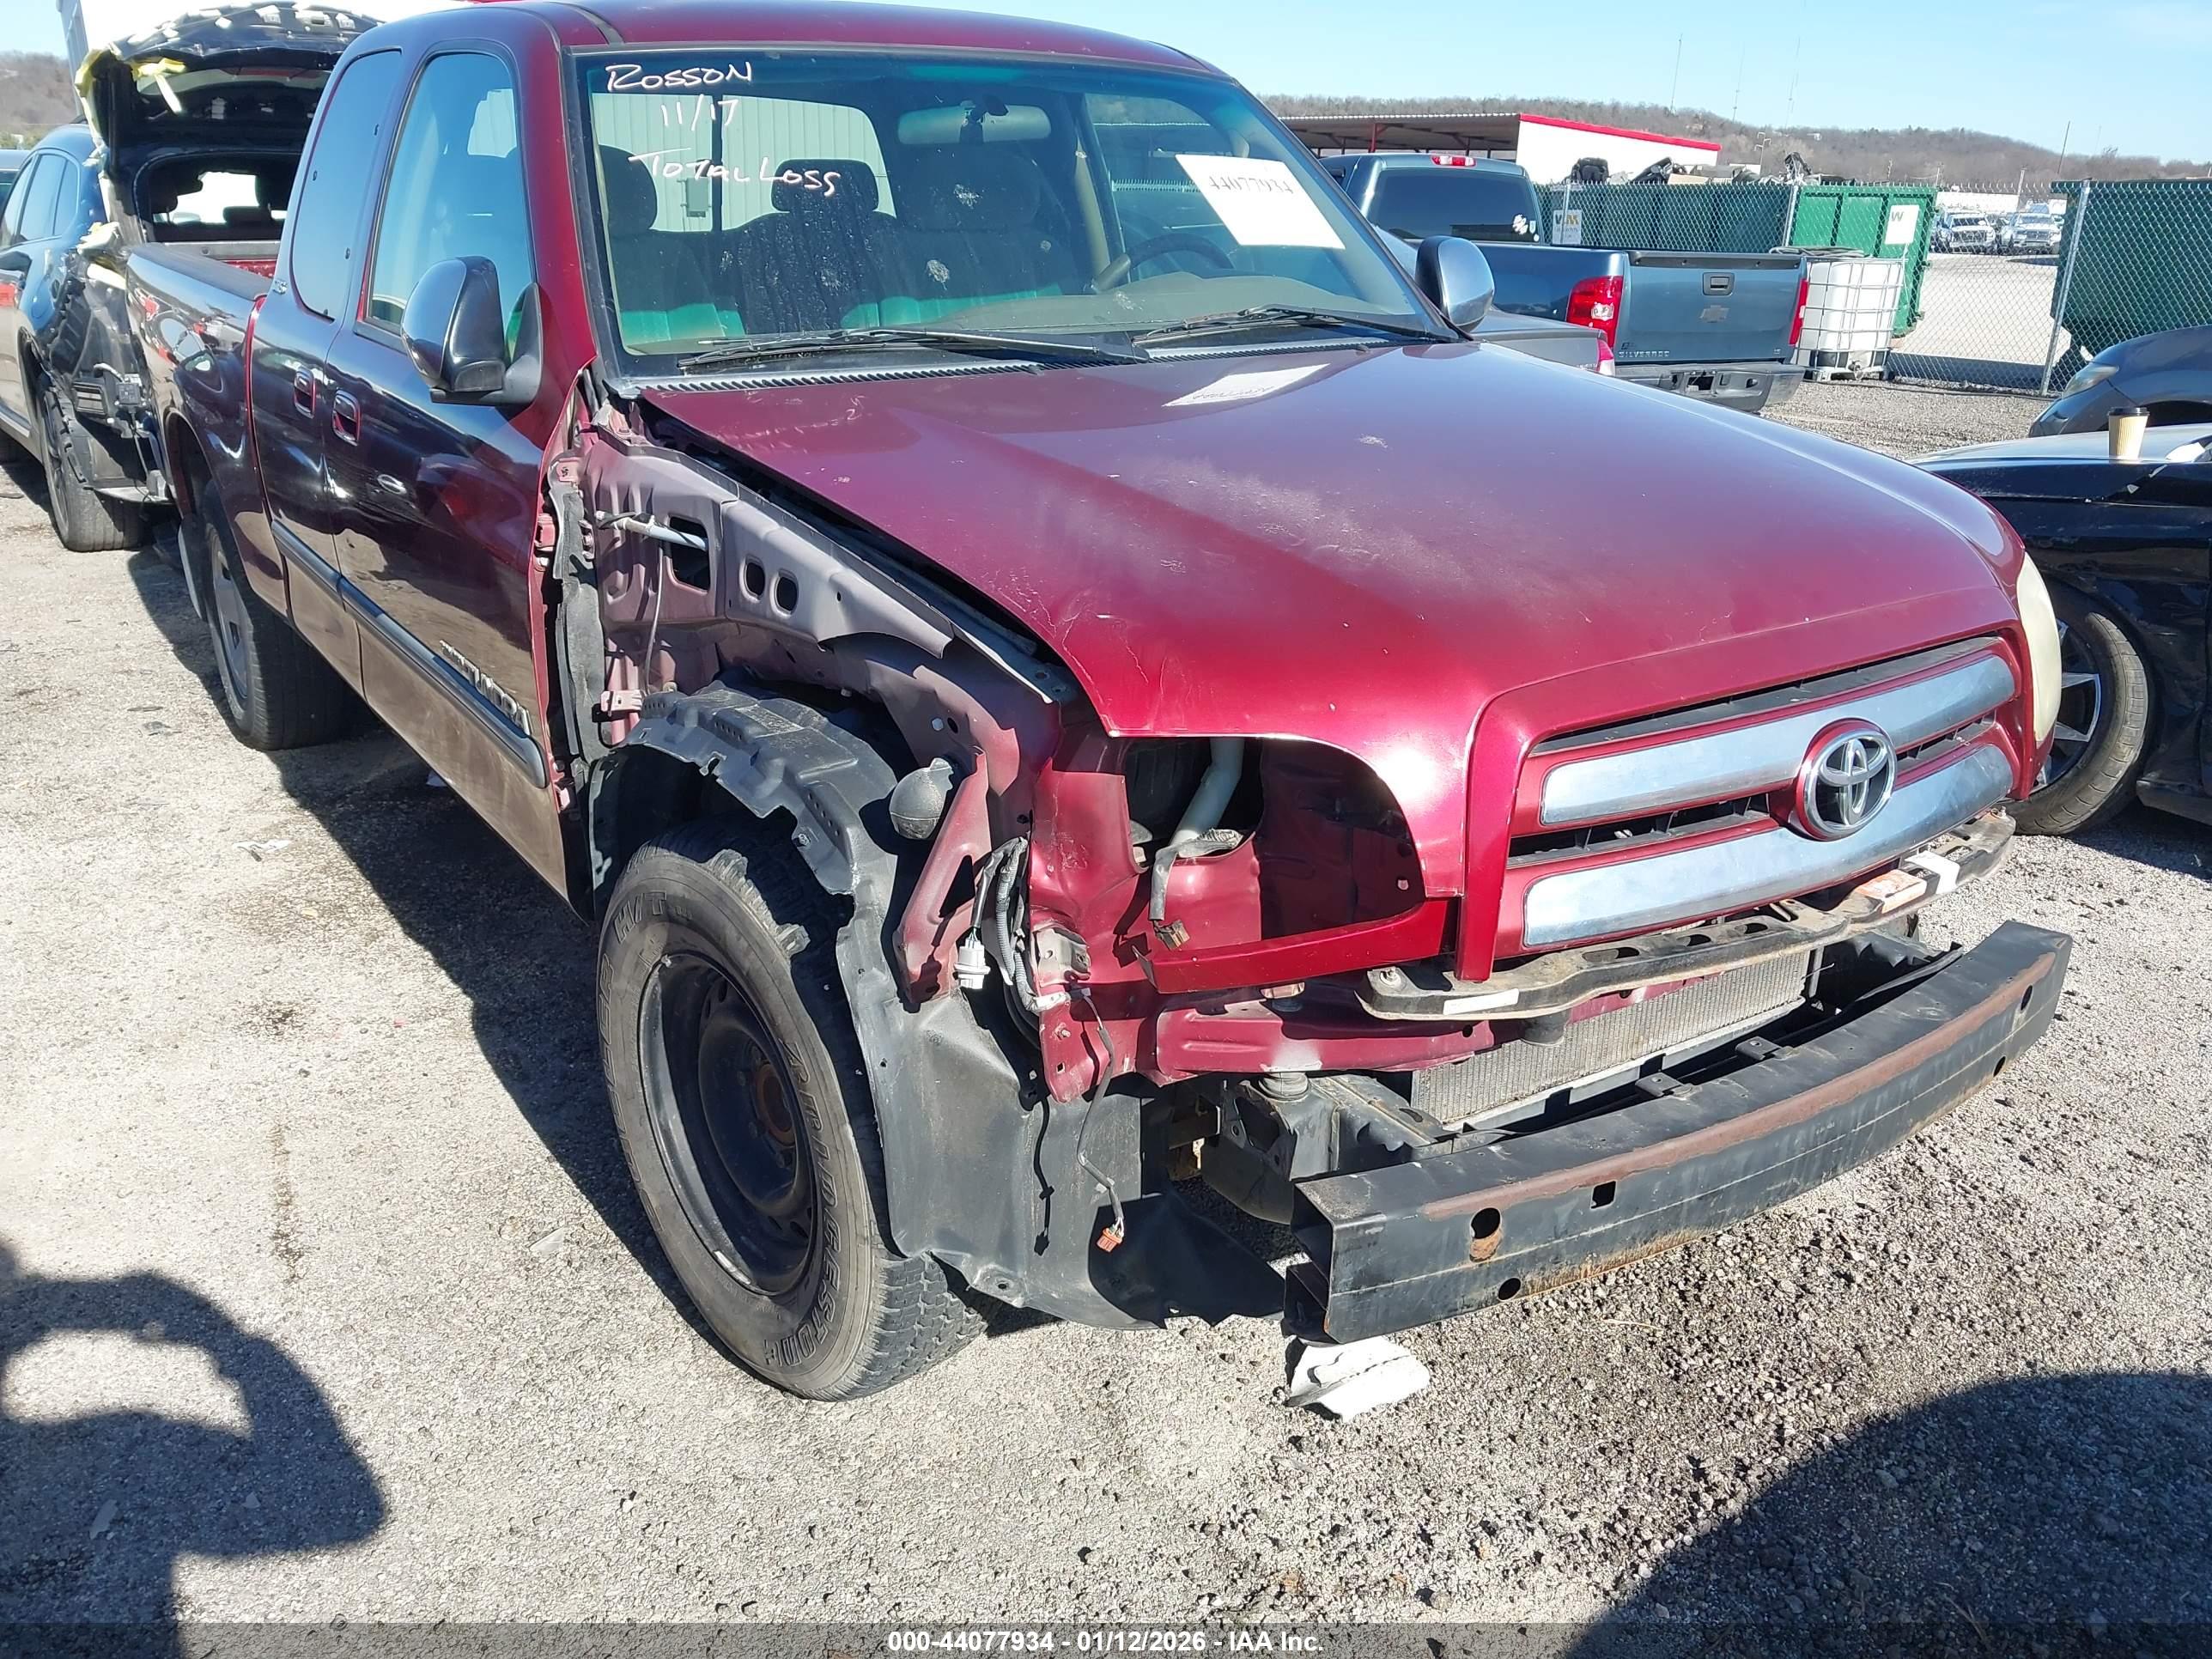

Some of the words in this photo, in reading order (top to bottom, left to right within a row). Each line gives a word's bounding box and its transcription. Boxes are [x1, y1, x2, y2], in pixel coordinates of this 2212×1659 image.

[605, 62, 751, 91] ROSSON
[661, 94, 738, 131] 11/17
[614, 890, 667, 945] H/T
[763, 1036, 842, 1368] BRIDGESTONE
